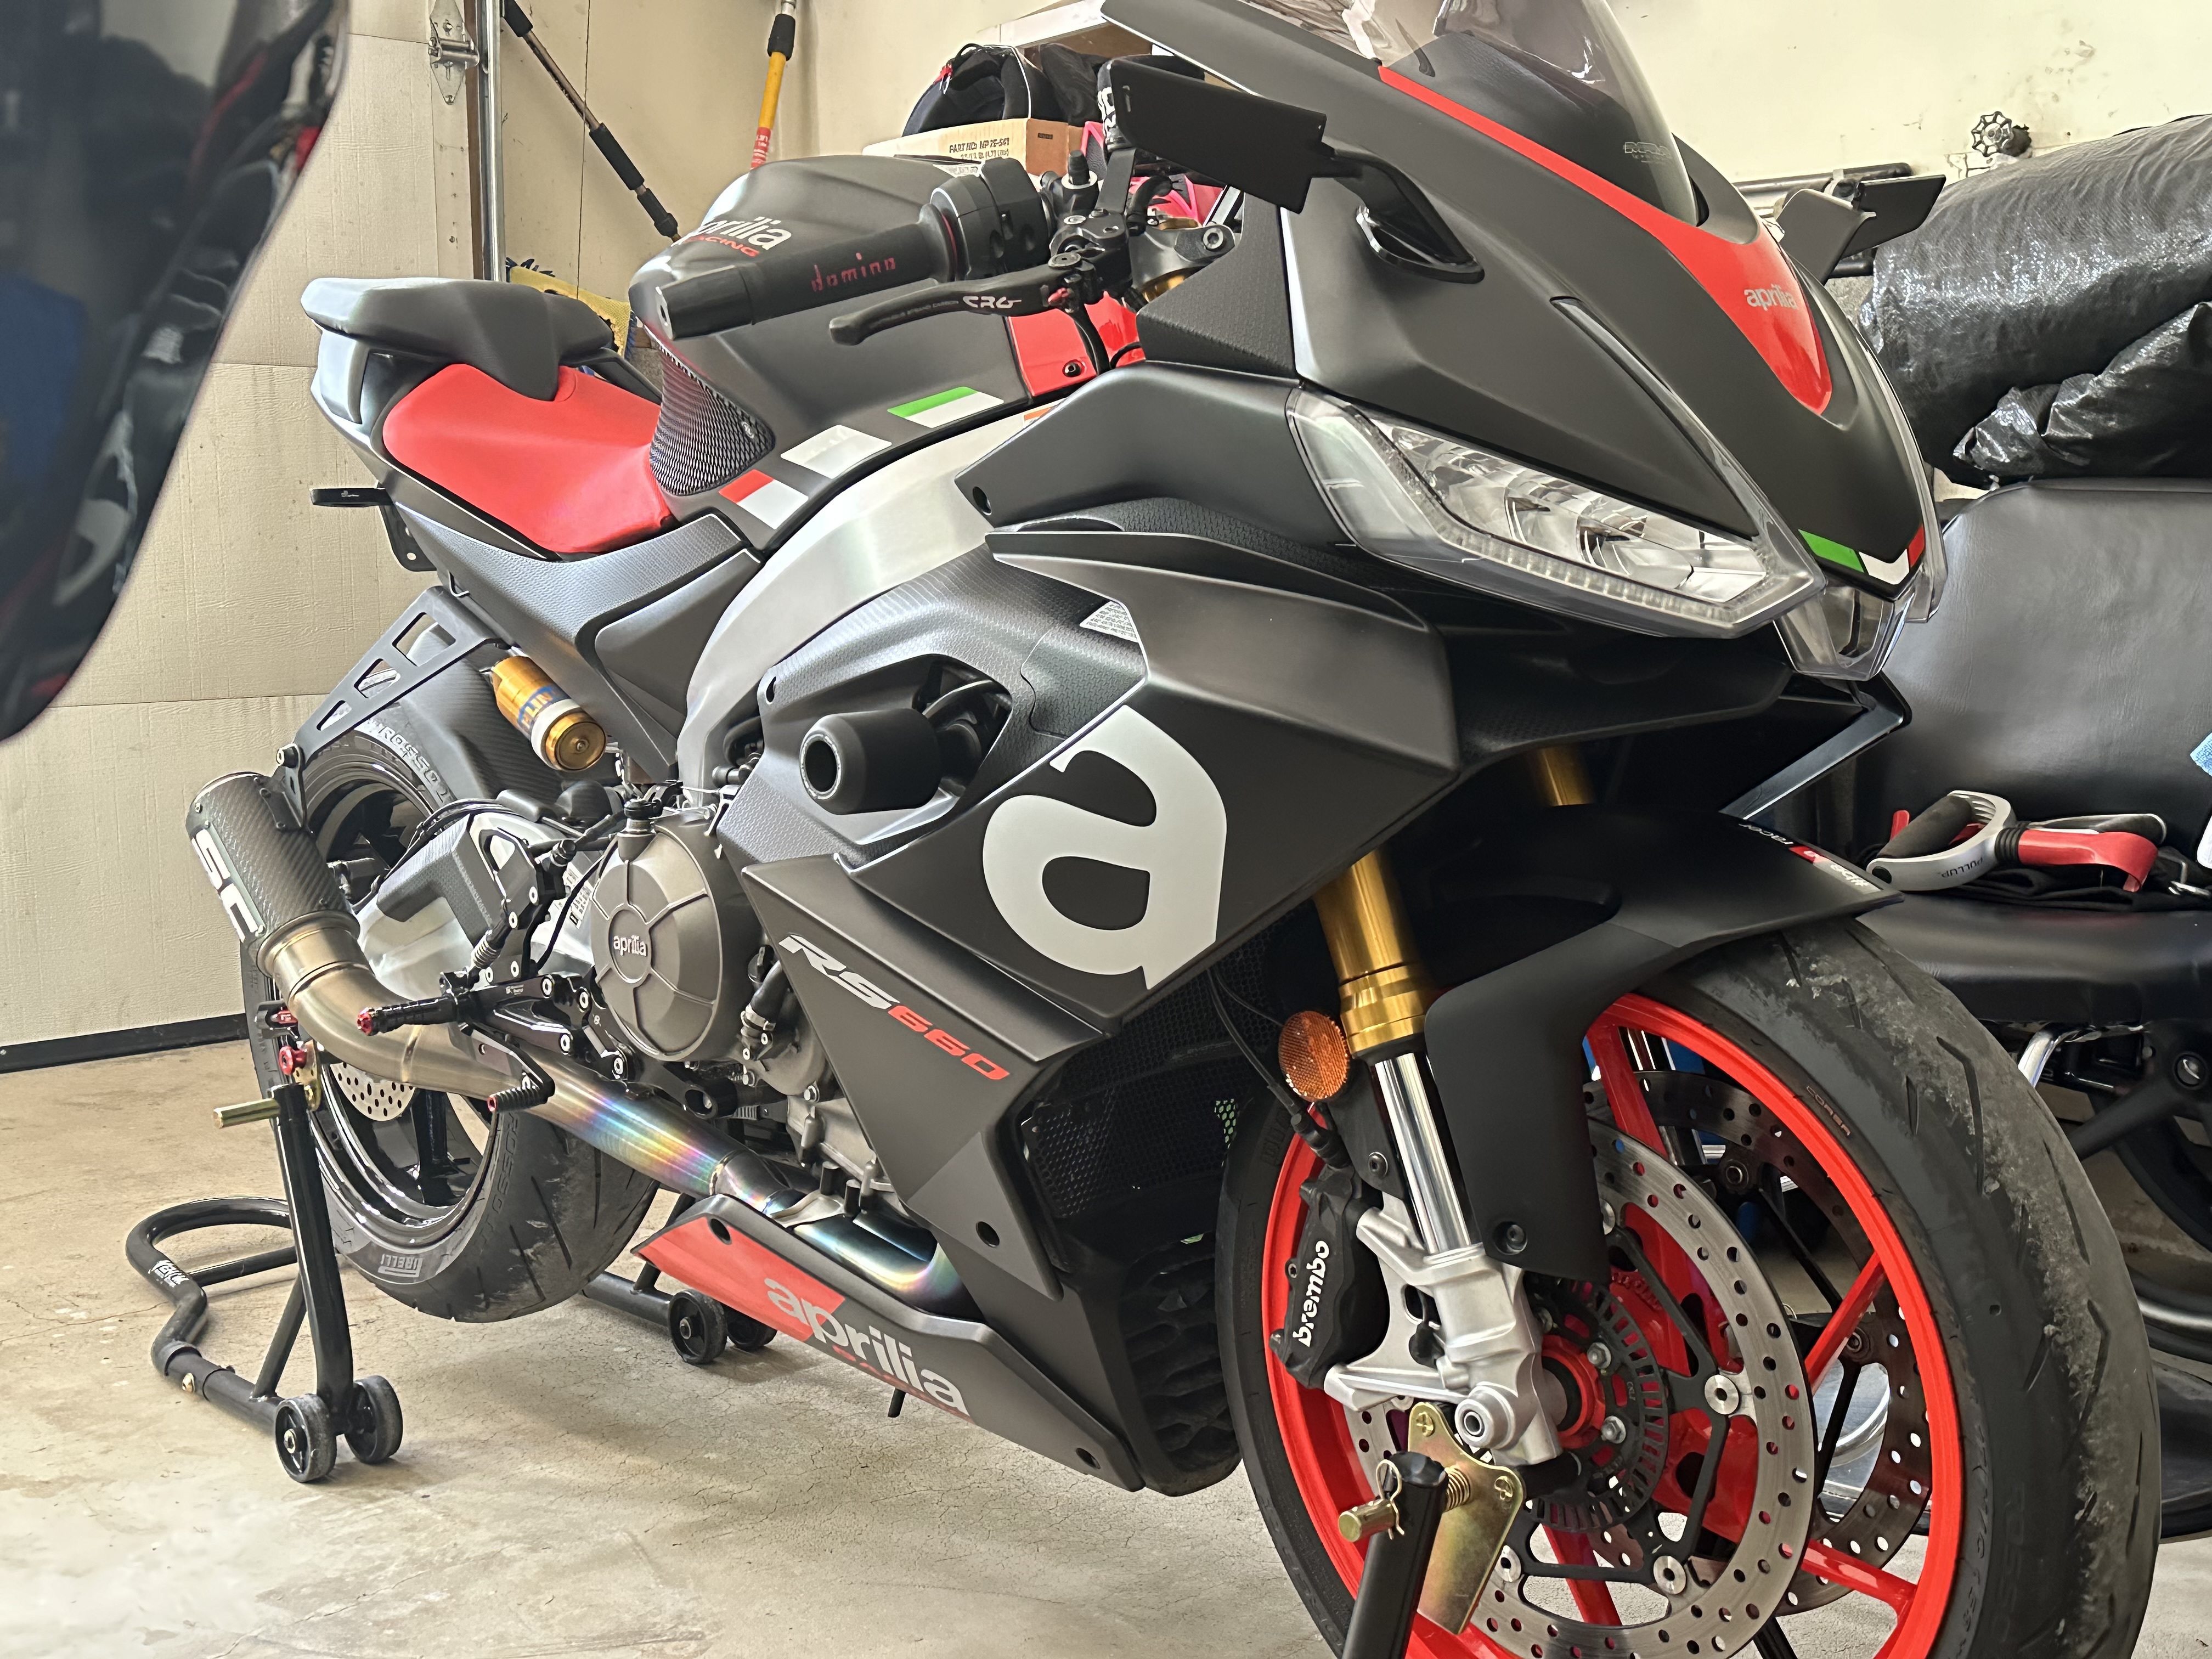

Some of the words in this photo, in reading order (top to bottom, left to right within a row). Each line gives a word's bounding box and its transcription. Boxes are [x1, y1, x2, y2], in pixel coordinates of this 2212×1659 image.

[811, 253, 896, 292] domino
[962, 296, 1022, 308] CRG
[1743, 283, 1798, 311] aprilia
[982, 704, 1225, 990] a
[613, 934, 646, 957] aprilia
[377, 1254, 424, 1278] PIRELLI
[1293, 1240, 1330, 1347] brembo
[764, 1278, 970, 1417] aprilia
